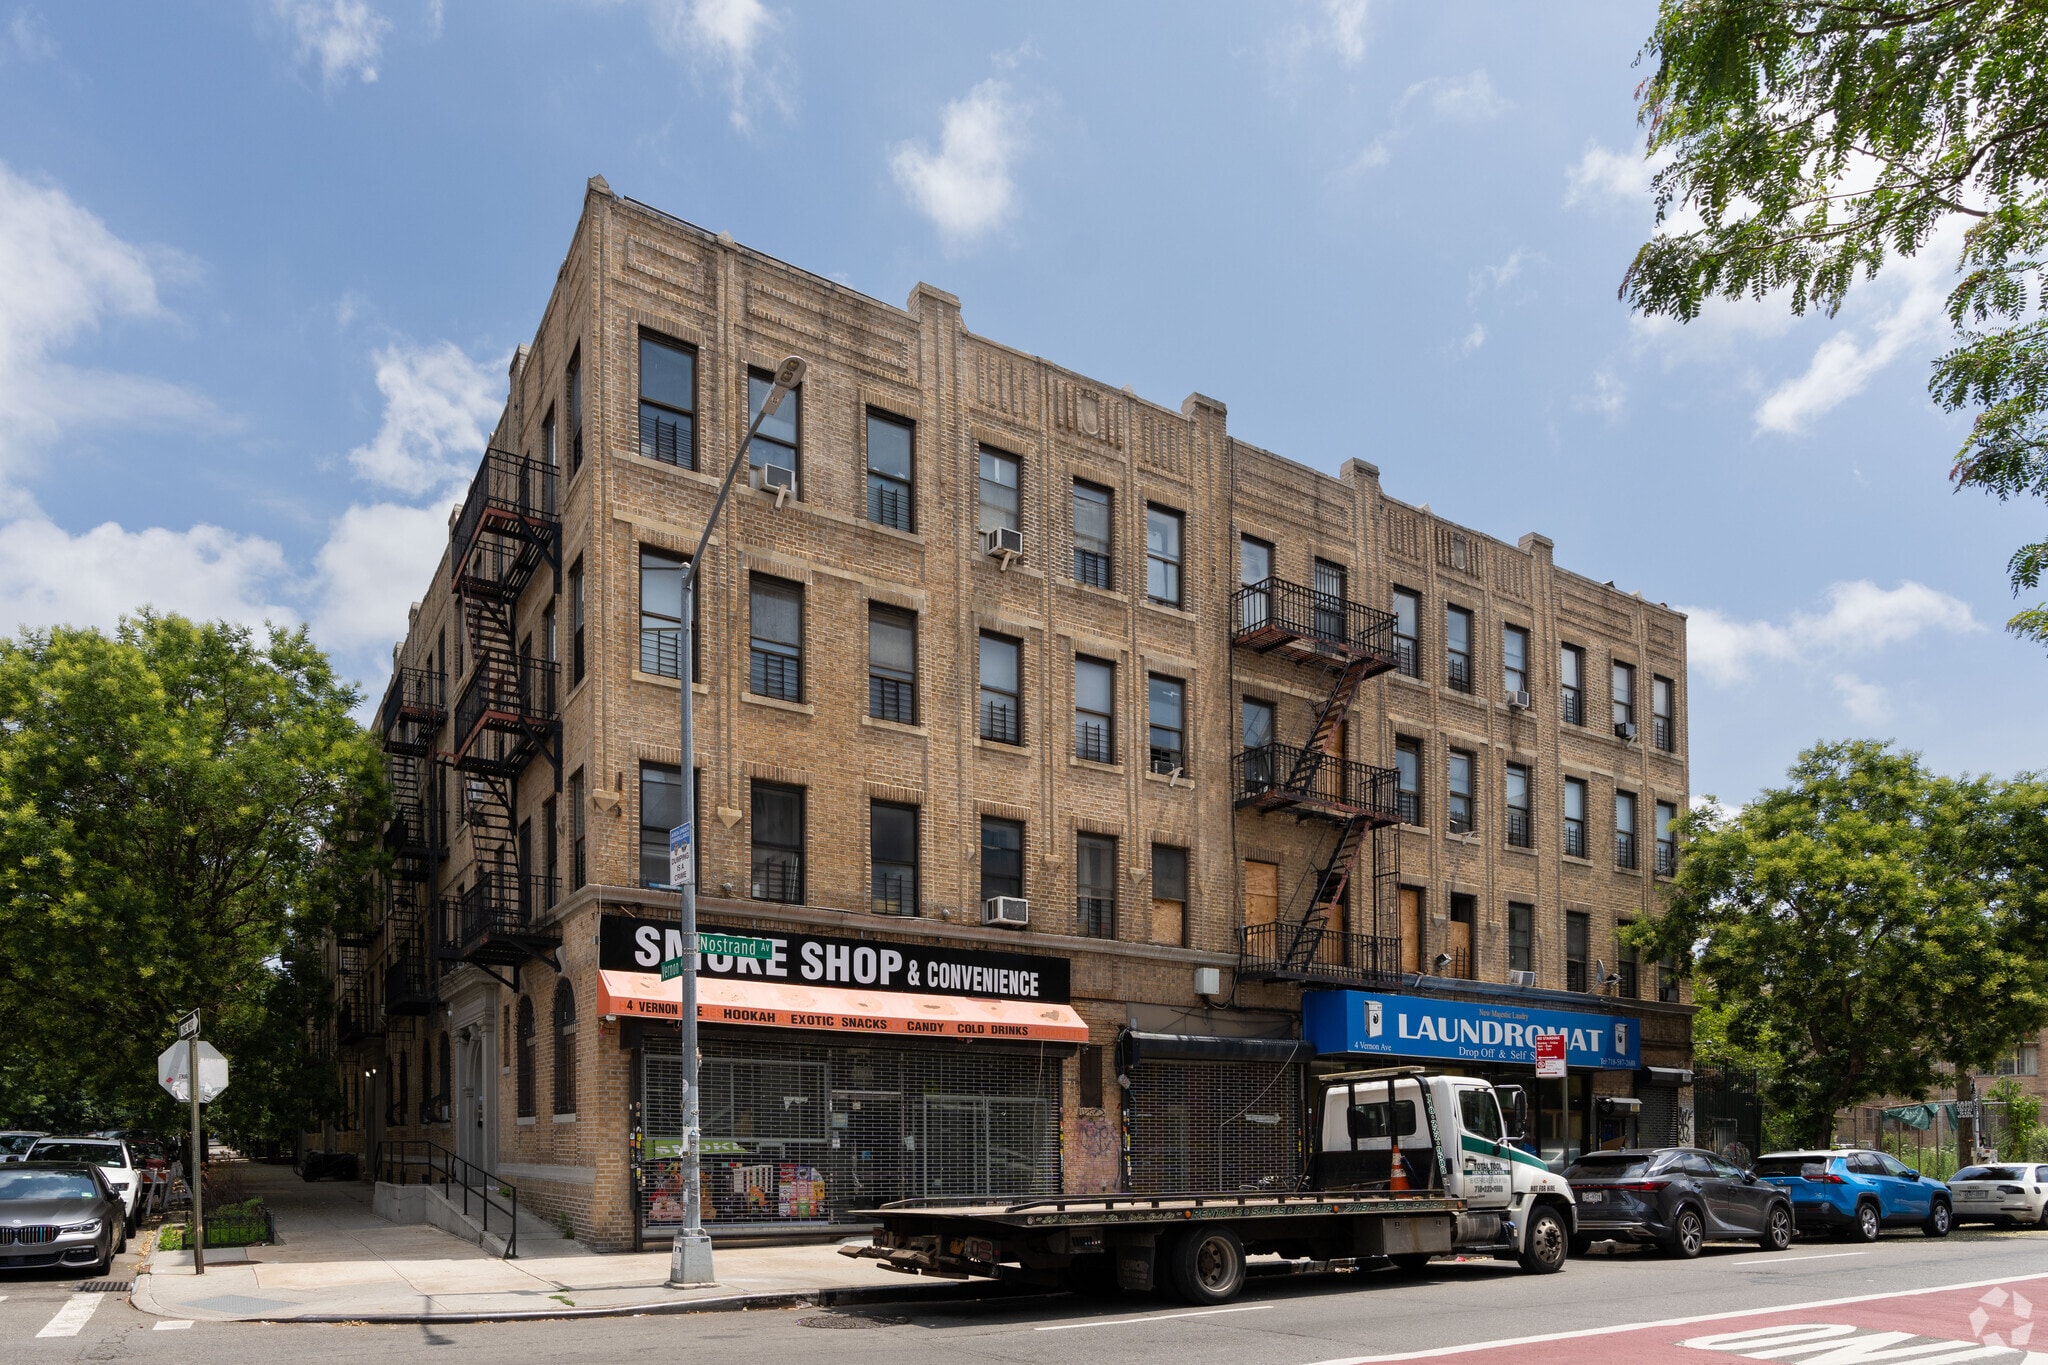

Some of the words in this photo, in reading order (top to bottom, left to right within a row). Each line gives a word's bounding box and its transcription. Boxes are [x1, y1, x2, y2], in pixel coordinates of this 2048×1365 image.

[671, 852, 690, 865] DUMPING
[674, 870, 687, 881] CRIME
[700, 938, 756, 956] Nostrand
[761, 942, 770, 952] Av
[661, 962, 680, 979] Vernon
[800, 941, 902, 986] SHOP
[908, 959, 920, 986] &
[927, 961, 1039, 997] CONVENIENCE
[626, 1000, 634, 1011] 4
[639, 1001, 678, 1015] VERNON
[723, 1008, 776, 1023] HOOKAH
[791, 1013, 834, 1027] EXOTIC
[841, 1016, 887, 1030] SNACKS
[907, 1020, 944, 1034] CANDY
[957, 1022, 985, 1035] COLD
[991, 1025, 1029, 1036] DRINKS
[1354, 1041, 1359, 1050] 4
[1359, 1042, 1380, 1051] Vernon
[1380, 1043, 1392, 1052] Ave
[1459, 1046, 1479, 1058] Drop
[1481, 1048, 1496, 1058] Off
[1498, 1050, 1506, 1059] &
[1510, 1050, 1528, 1060] Self
[655, 1142, 742, 1155] SOK
[1474, 1162, 1490, 1170] TOTAL
[1490, 1162, 1503, 1170] TOOL
[1192, 1208, 1243, 1218] RENTALS
[1251, 1206, 1287, 1217] SALES
[1294, 1204, 1332, 1215] REPAIR
